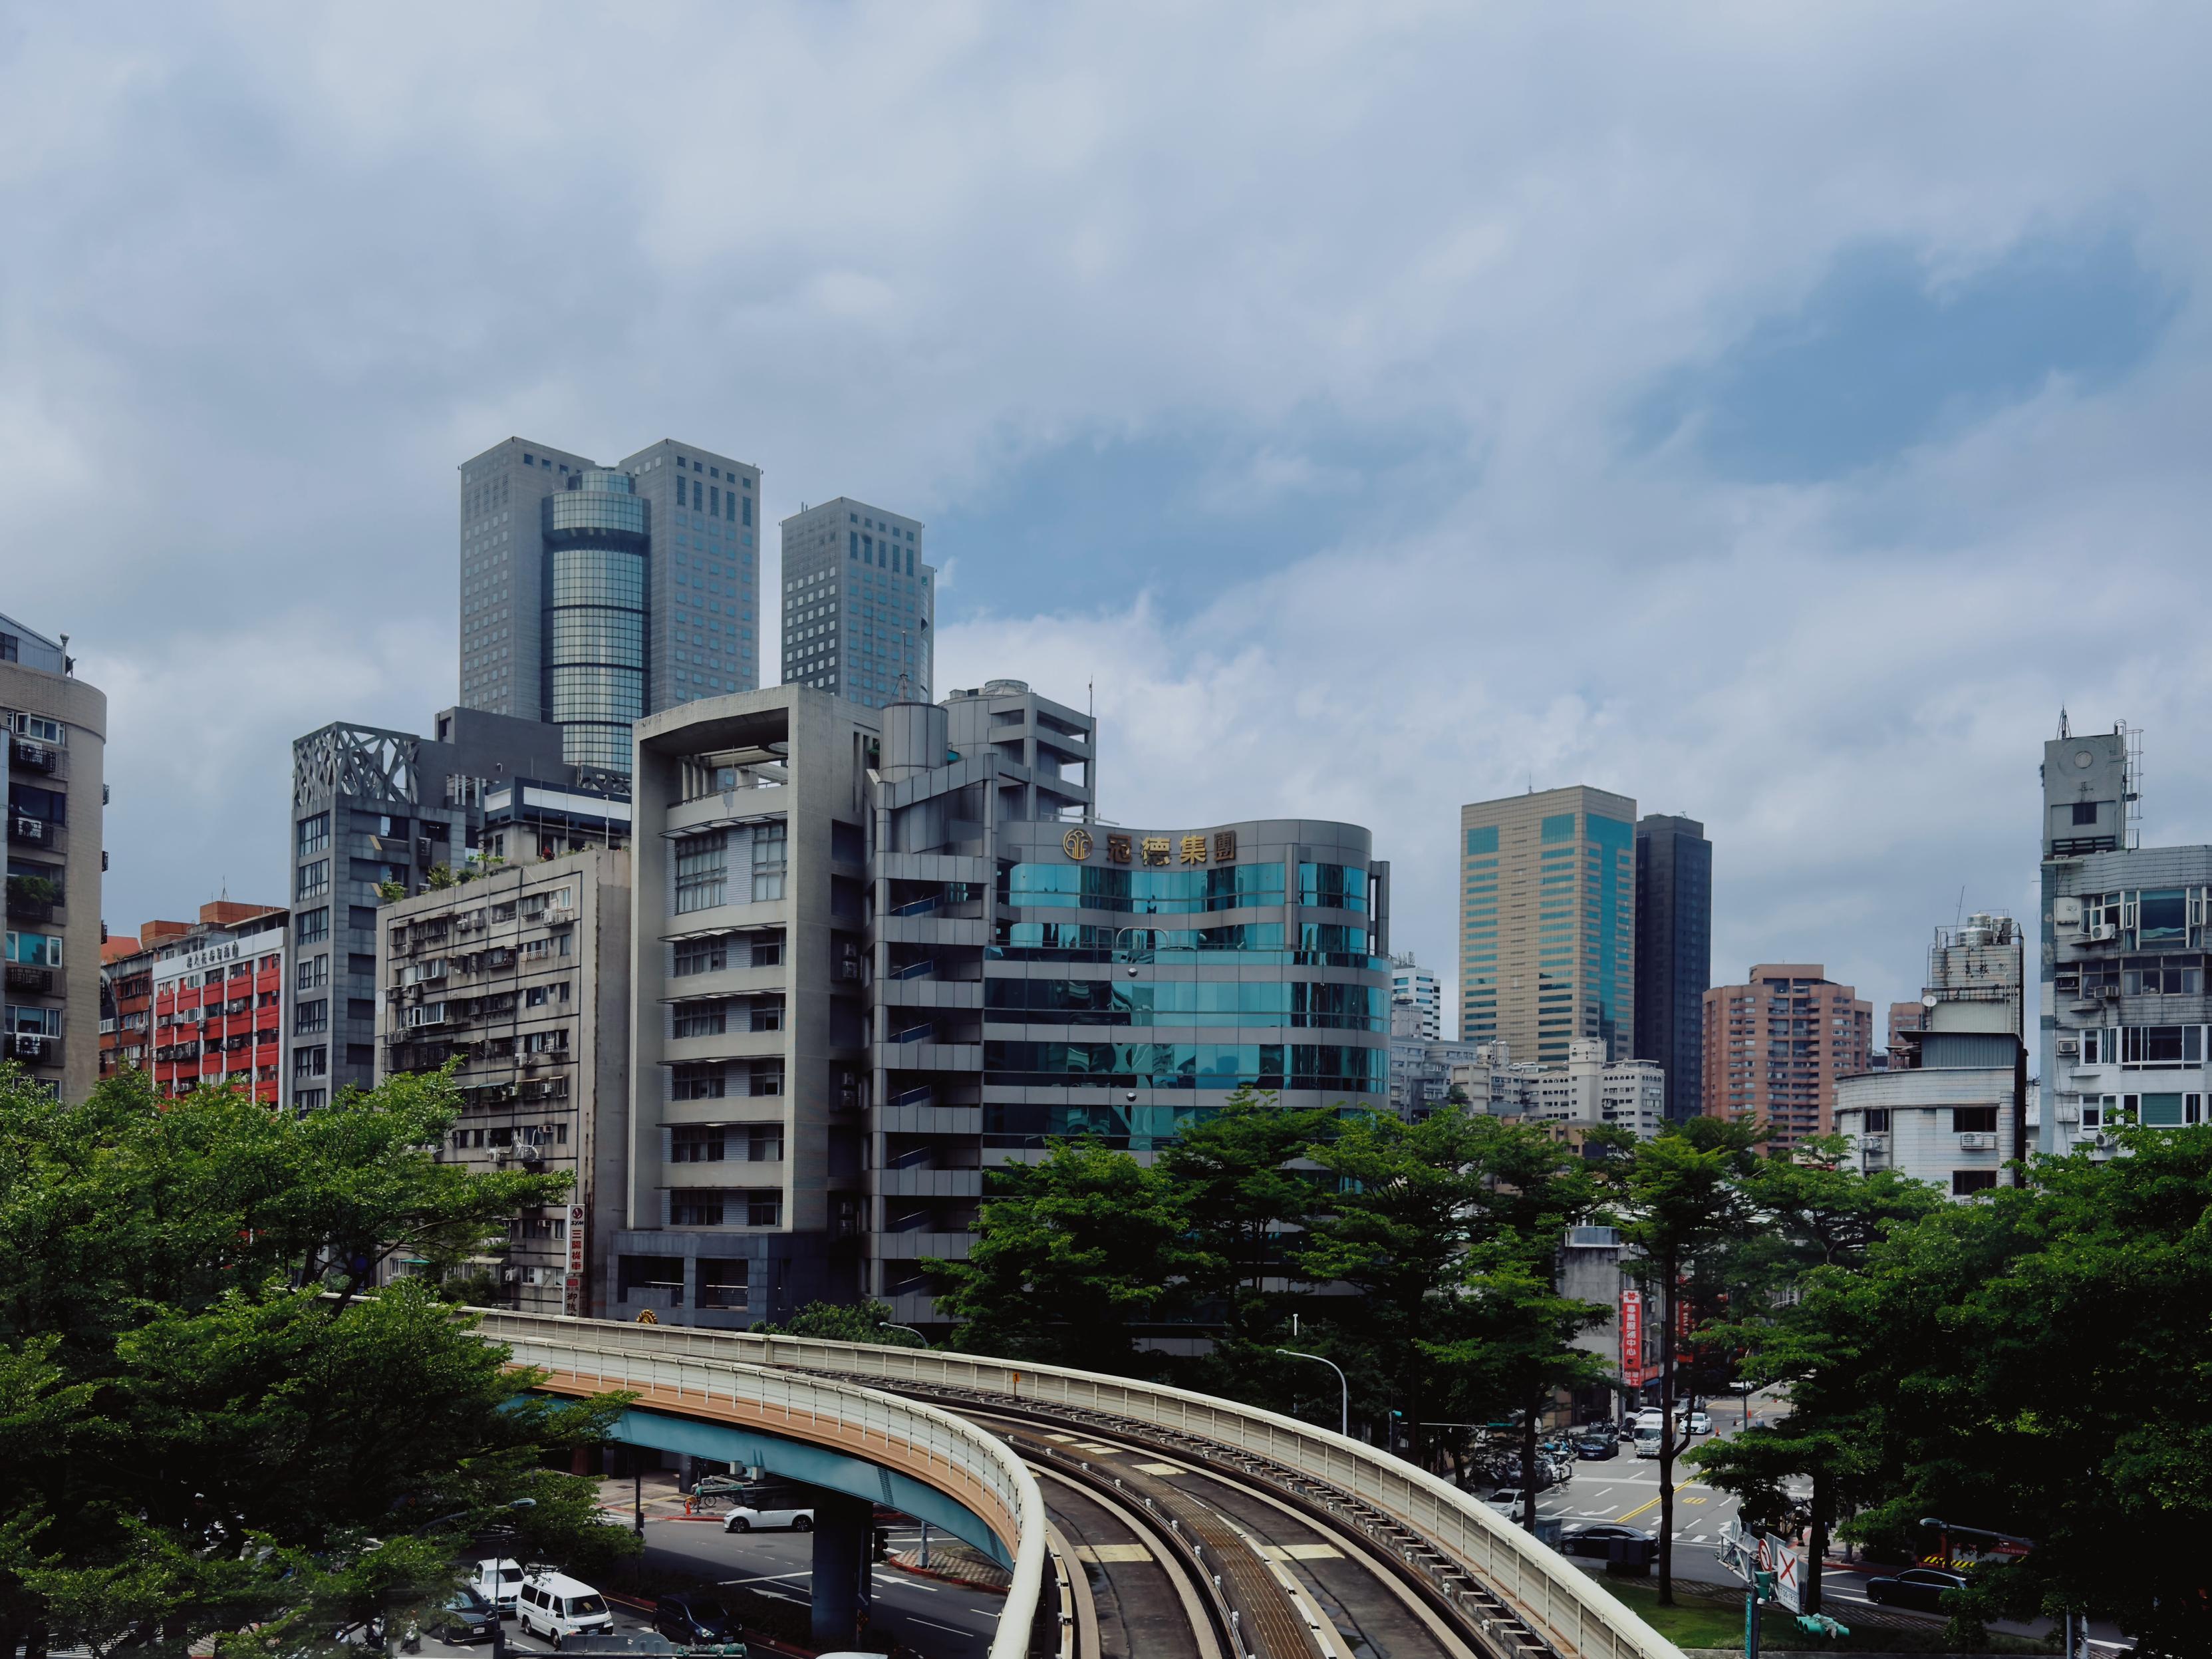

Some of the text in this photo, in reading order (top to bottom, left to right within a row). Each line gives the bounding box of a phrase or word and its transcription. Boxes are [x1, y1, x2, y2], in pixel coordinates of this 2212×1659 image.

[1107, 830, 1236, 866] 冠德集團
[572, 1229, 582, 1271] 三陽機車
